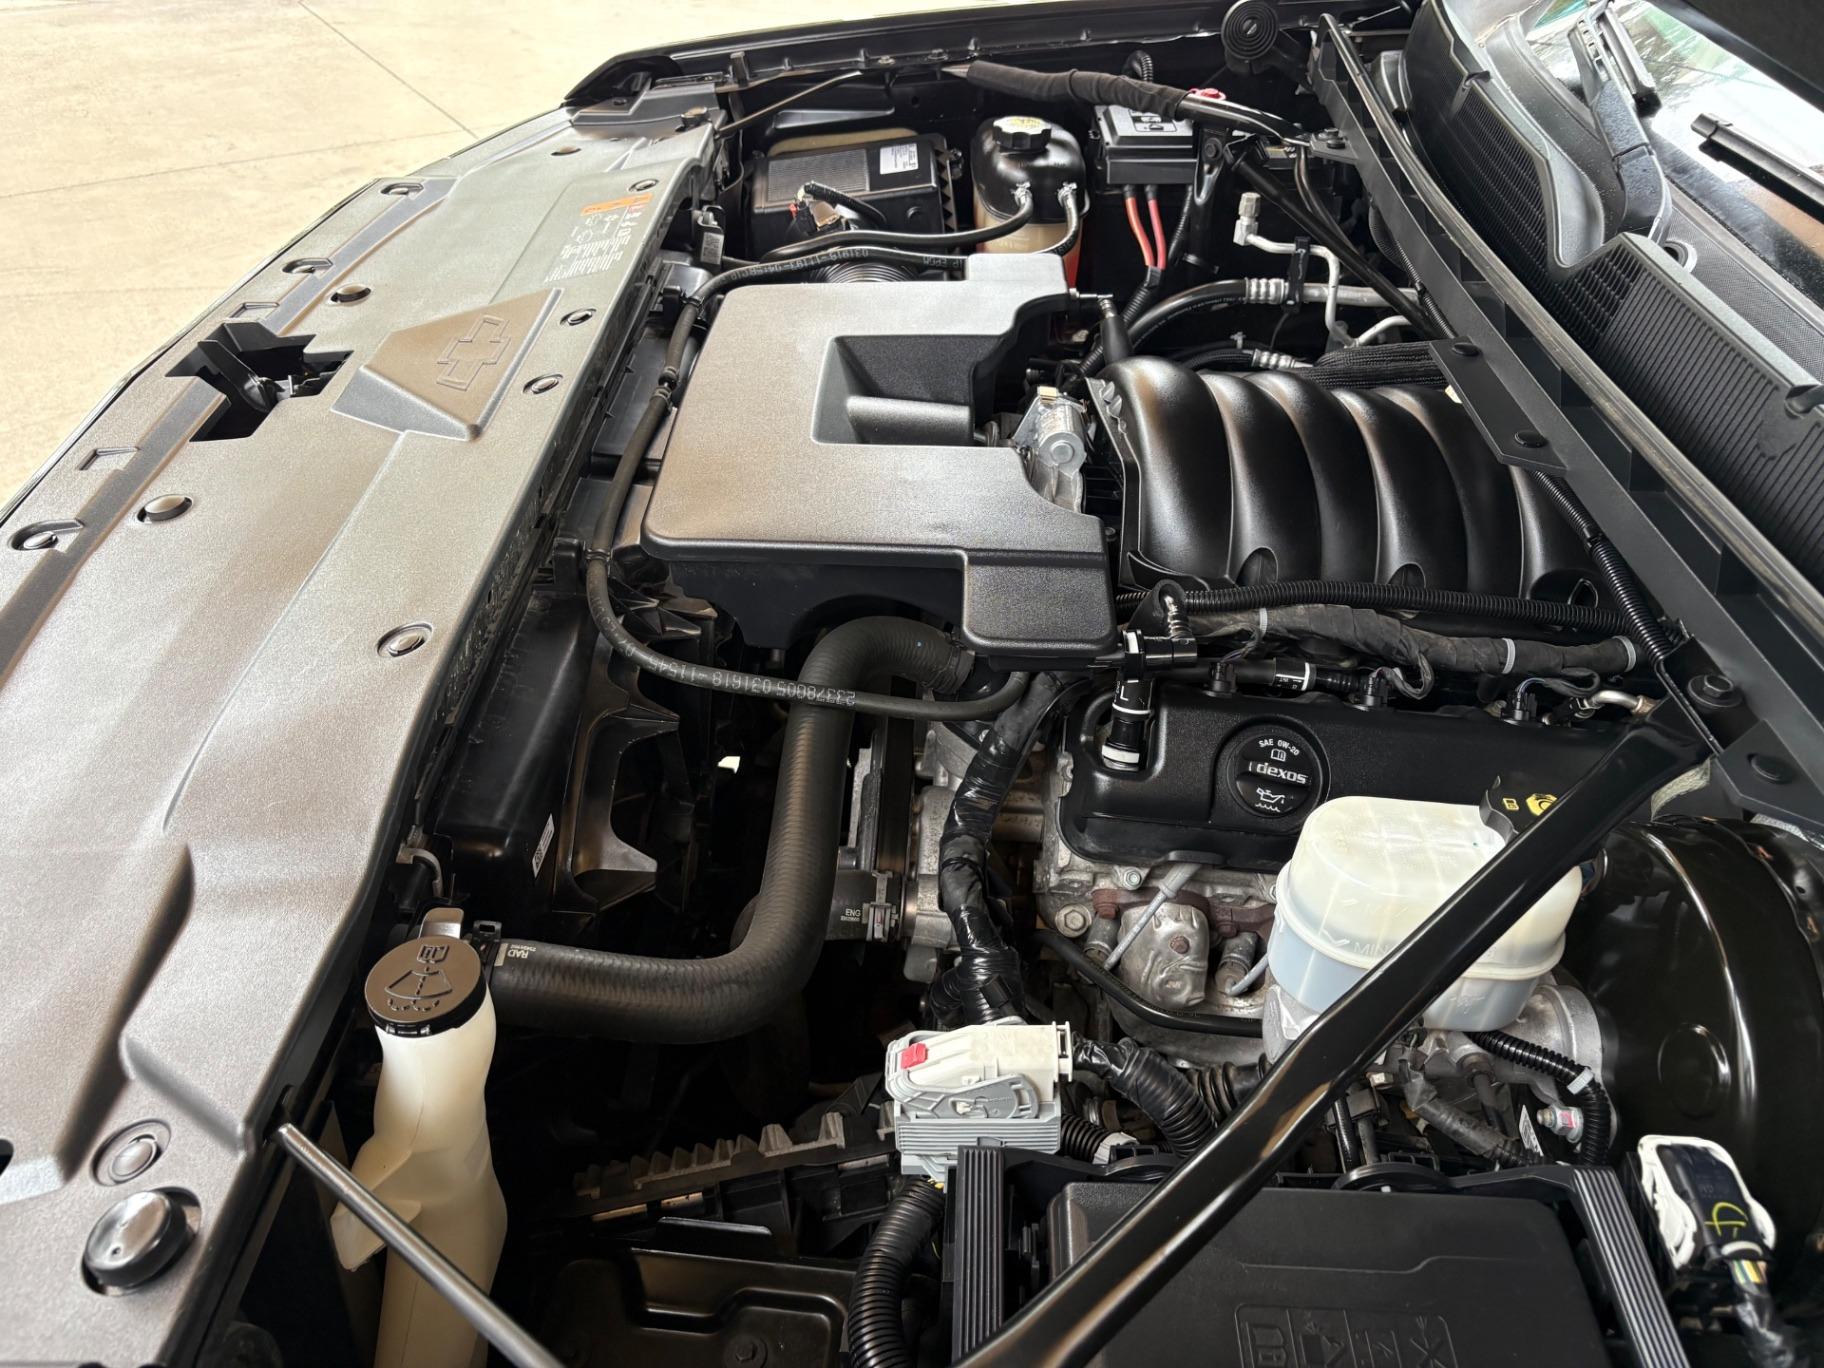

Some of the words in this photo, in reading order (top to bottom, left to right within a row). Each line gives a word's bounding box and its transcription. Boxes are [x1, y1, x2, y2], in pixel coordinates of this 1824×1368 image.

[1258, 738, 1274, 748] SAE
[1277, 739, 1300, 756] 0W-20
[1256, 762, 1309, 785] dexos
[845, 908, 861, 917] ENG
[507, 949, 529, 959] RAD
